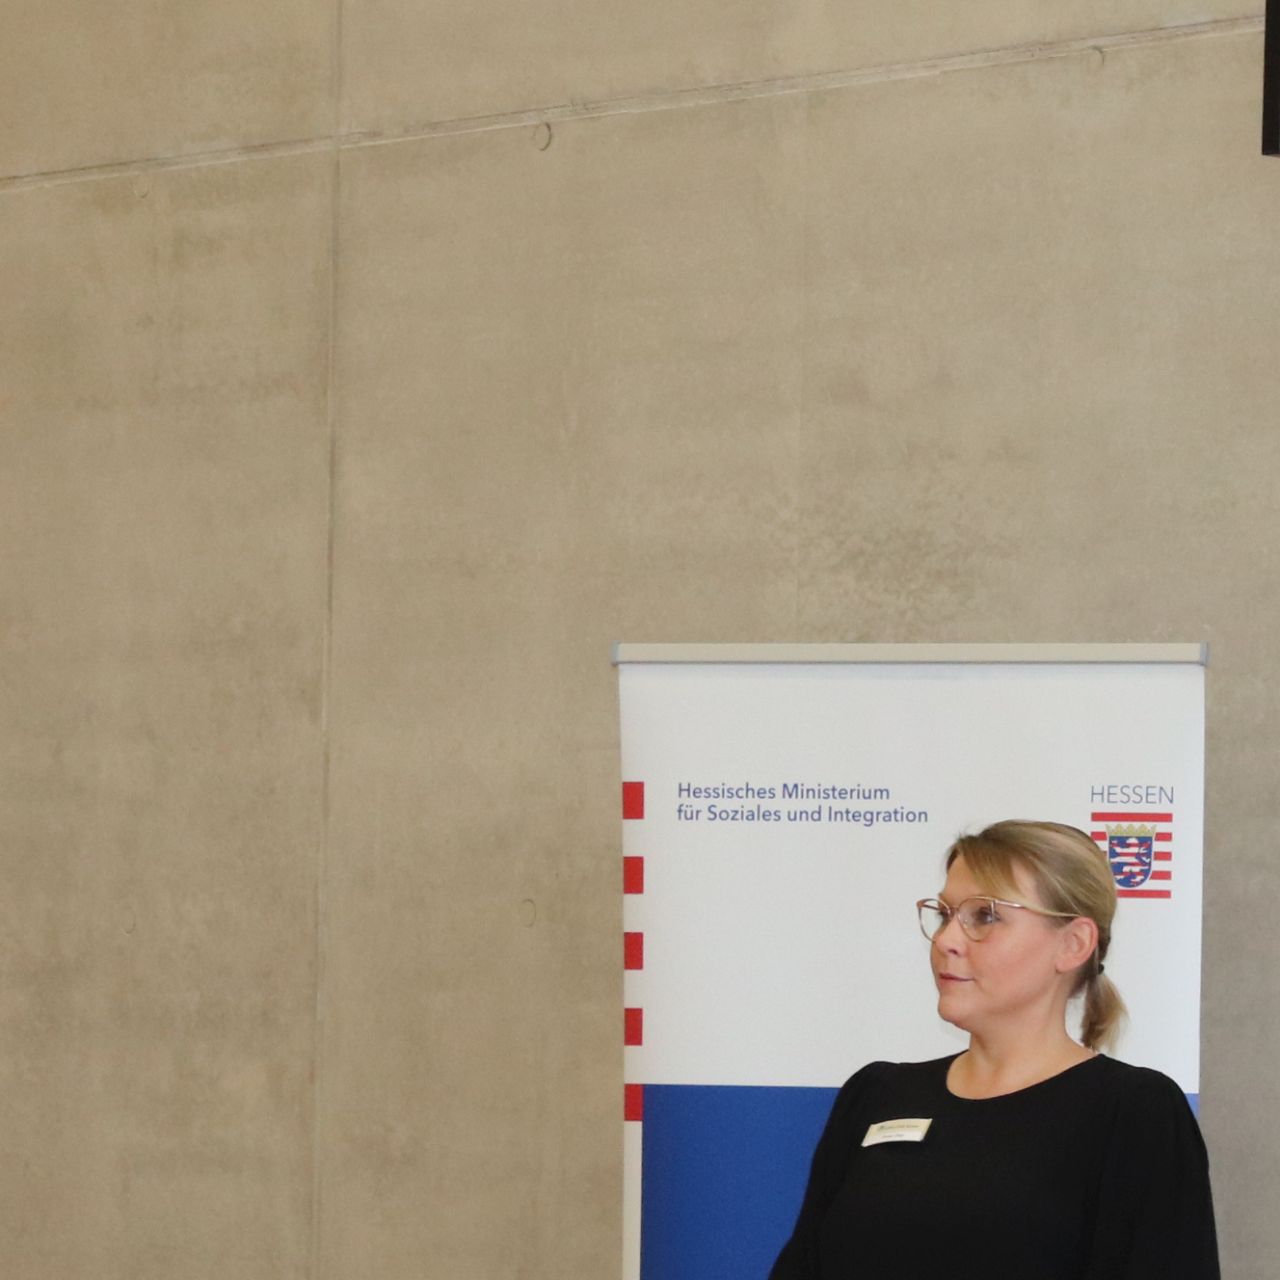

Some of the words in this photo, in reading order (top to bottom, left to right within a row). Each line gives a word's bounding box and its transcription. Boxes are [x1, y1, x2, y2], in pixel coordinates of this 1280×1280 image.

[678, 782, 776, 799] Hessisches
[783, 783, 890, 800] Ministerium
[1090, 785, 1174, 804] HESSEN
[677, 804, 702, 821] für
[707, 804, 781, 822] Soziales
[787, 805, 822, 822] und
[828, 806, 928, 827] Integration
